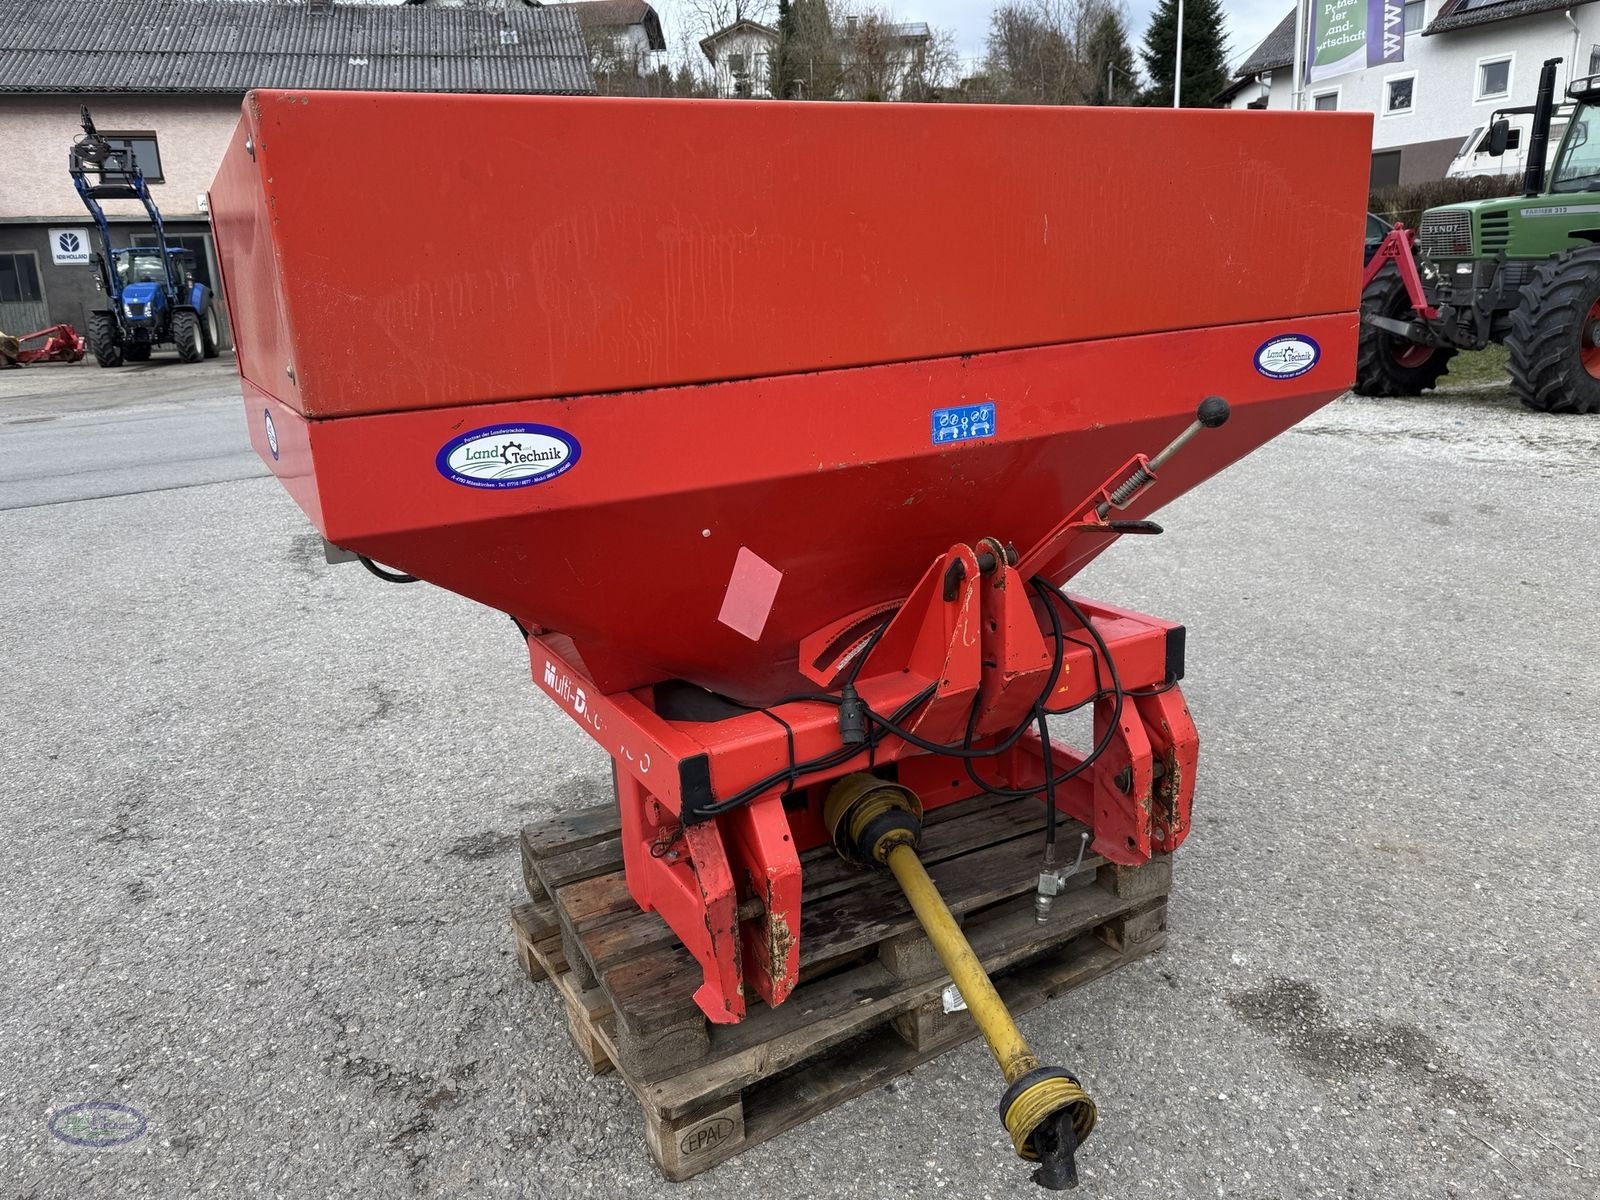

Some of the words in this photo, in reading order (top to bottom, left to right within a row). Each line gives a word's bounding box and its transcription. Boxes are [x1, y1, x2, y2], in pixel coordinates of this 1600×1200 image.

[1325, 21, 1354, 36] and-
[1428, 224, 1459, 233] FENDT
[1267, 348, 1283, 359] Land
[1288, 351, 1311, 362] Technik
[465, 445, 499, 461] Land
[511, 447, 561, 464] Technik
[688, 1123, 728, 1153] EPAL
